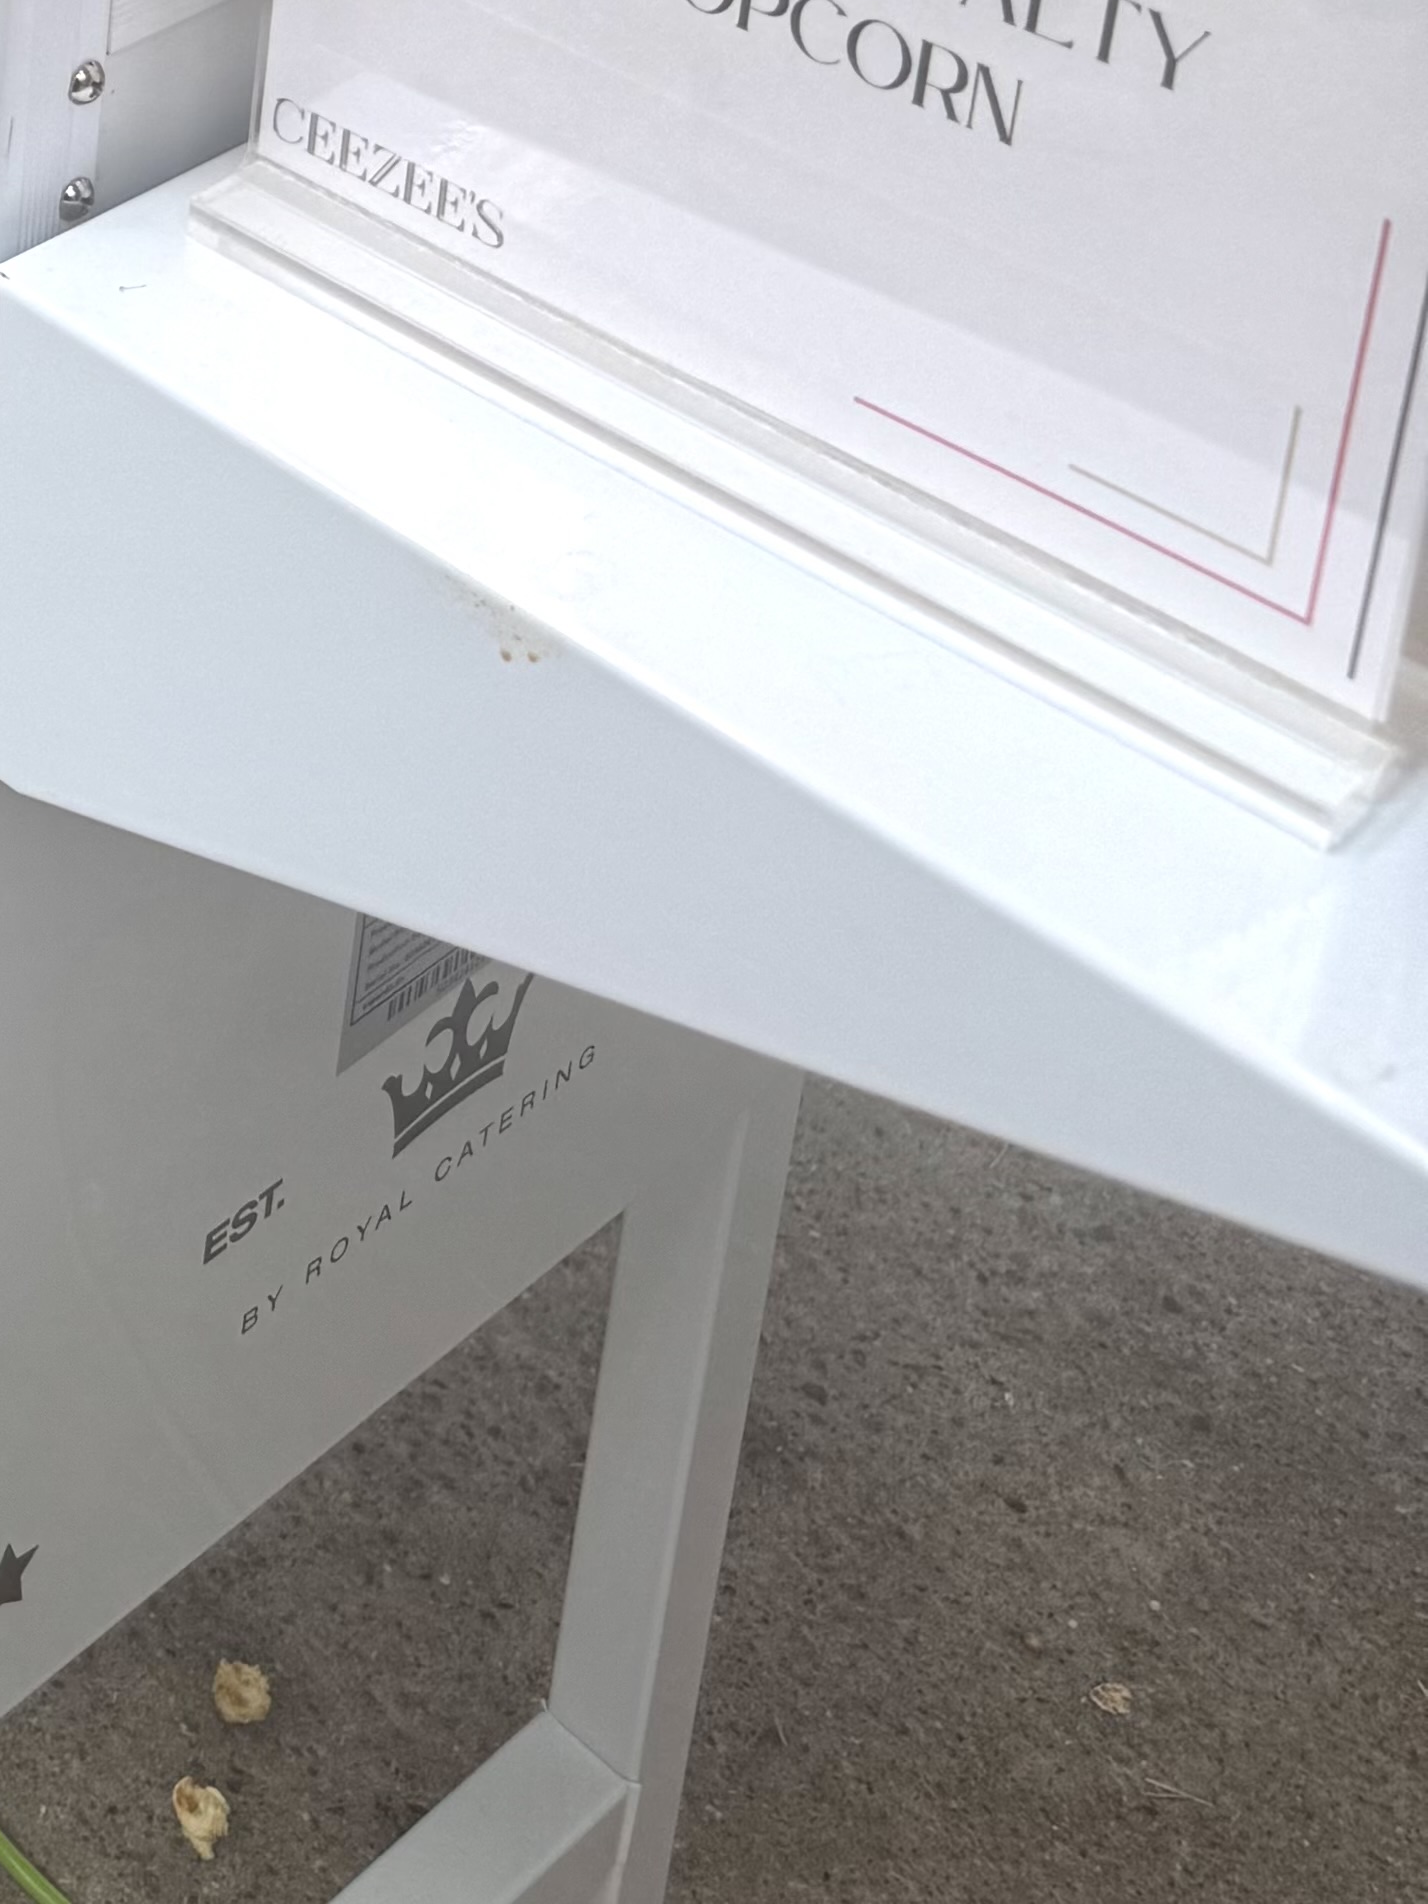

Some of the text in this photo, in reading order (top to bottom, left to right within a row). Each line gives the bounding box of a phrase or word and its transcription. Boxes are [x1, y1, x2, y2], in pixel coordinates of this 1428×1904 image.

[271, 97, 505, 250] CEEZEE'S
[201, 1177, 285, 1266] EST.
[239, 1044, 596, 1336] BY ROYAL CATERING
